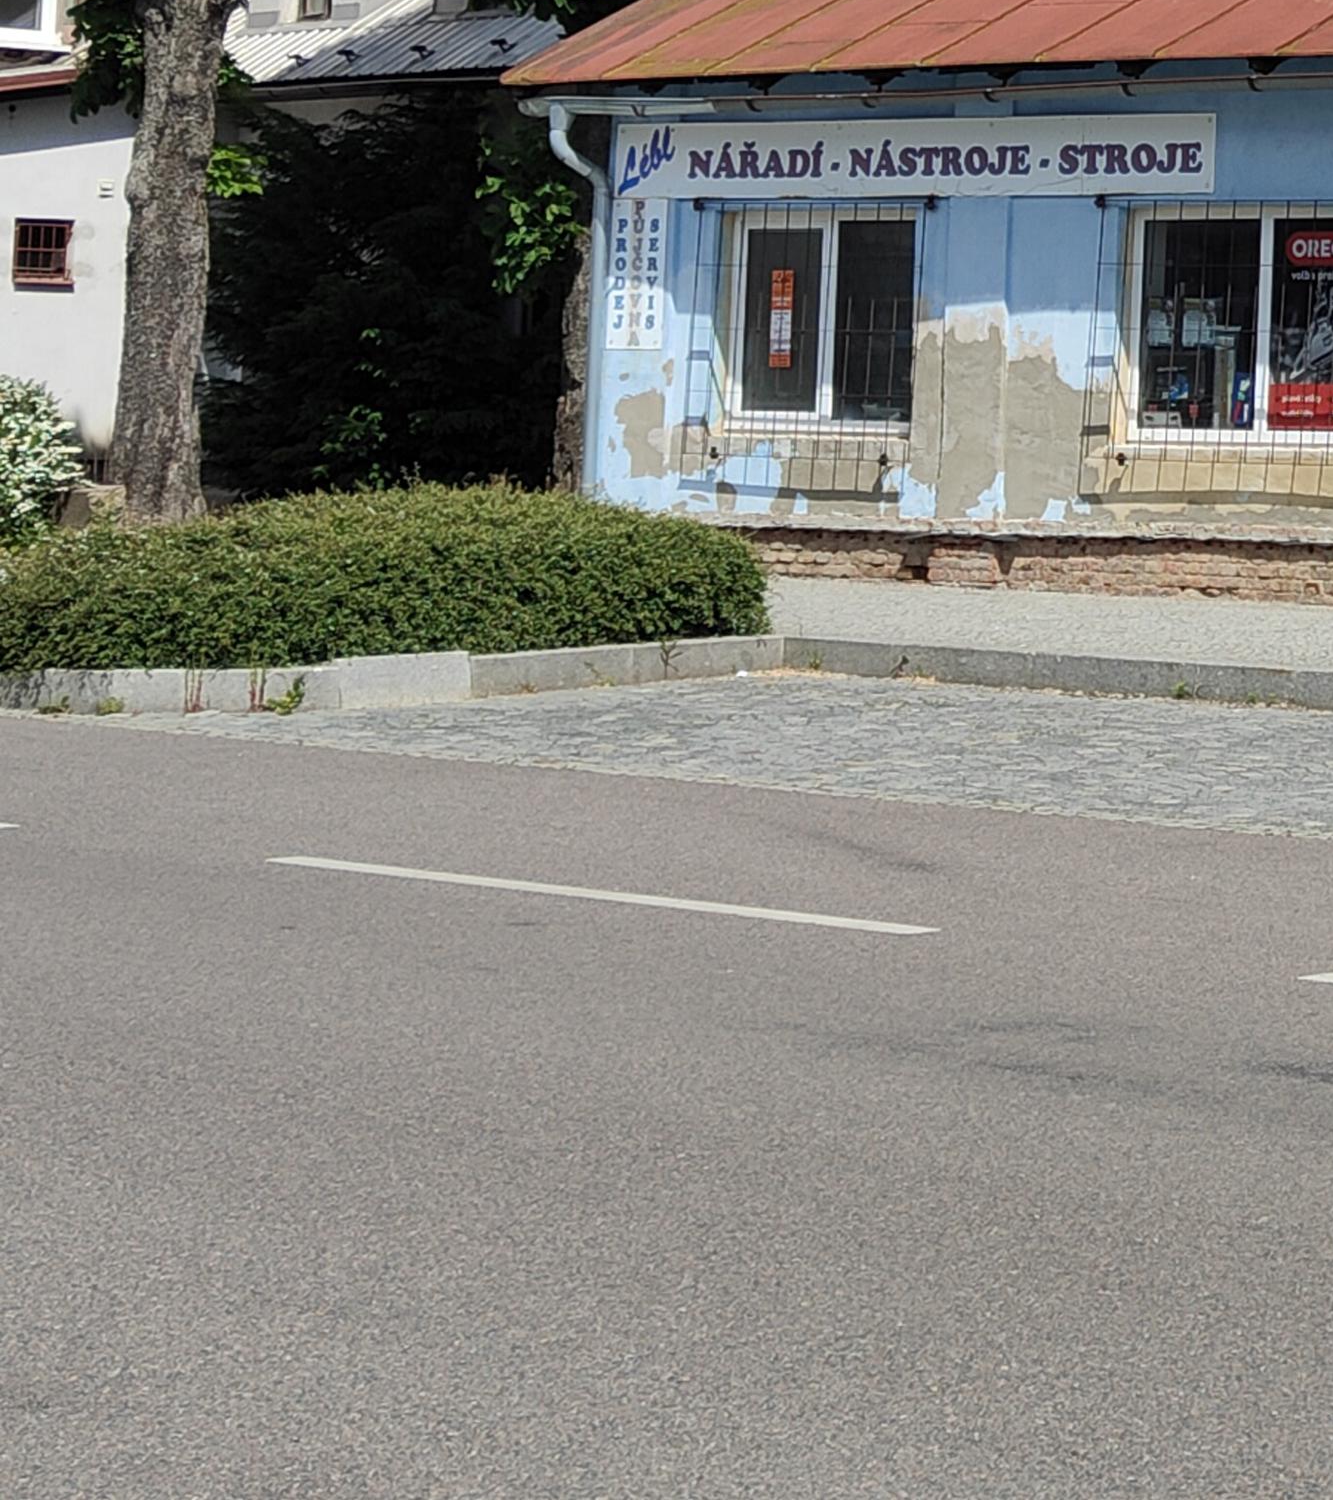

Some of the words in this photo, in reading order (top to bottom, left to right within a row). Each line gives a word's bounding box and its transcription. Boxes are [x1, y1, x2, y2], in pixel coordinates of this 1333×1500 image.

[618, 125, 676, 196] Lébl
[687, 140, 825, 179] NÁŘADÍ
[848, 138, 1031, 178] NÁSTROJE
[1058, 141, 1203, 176] STROJE
